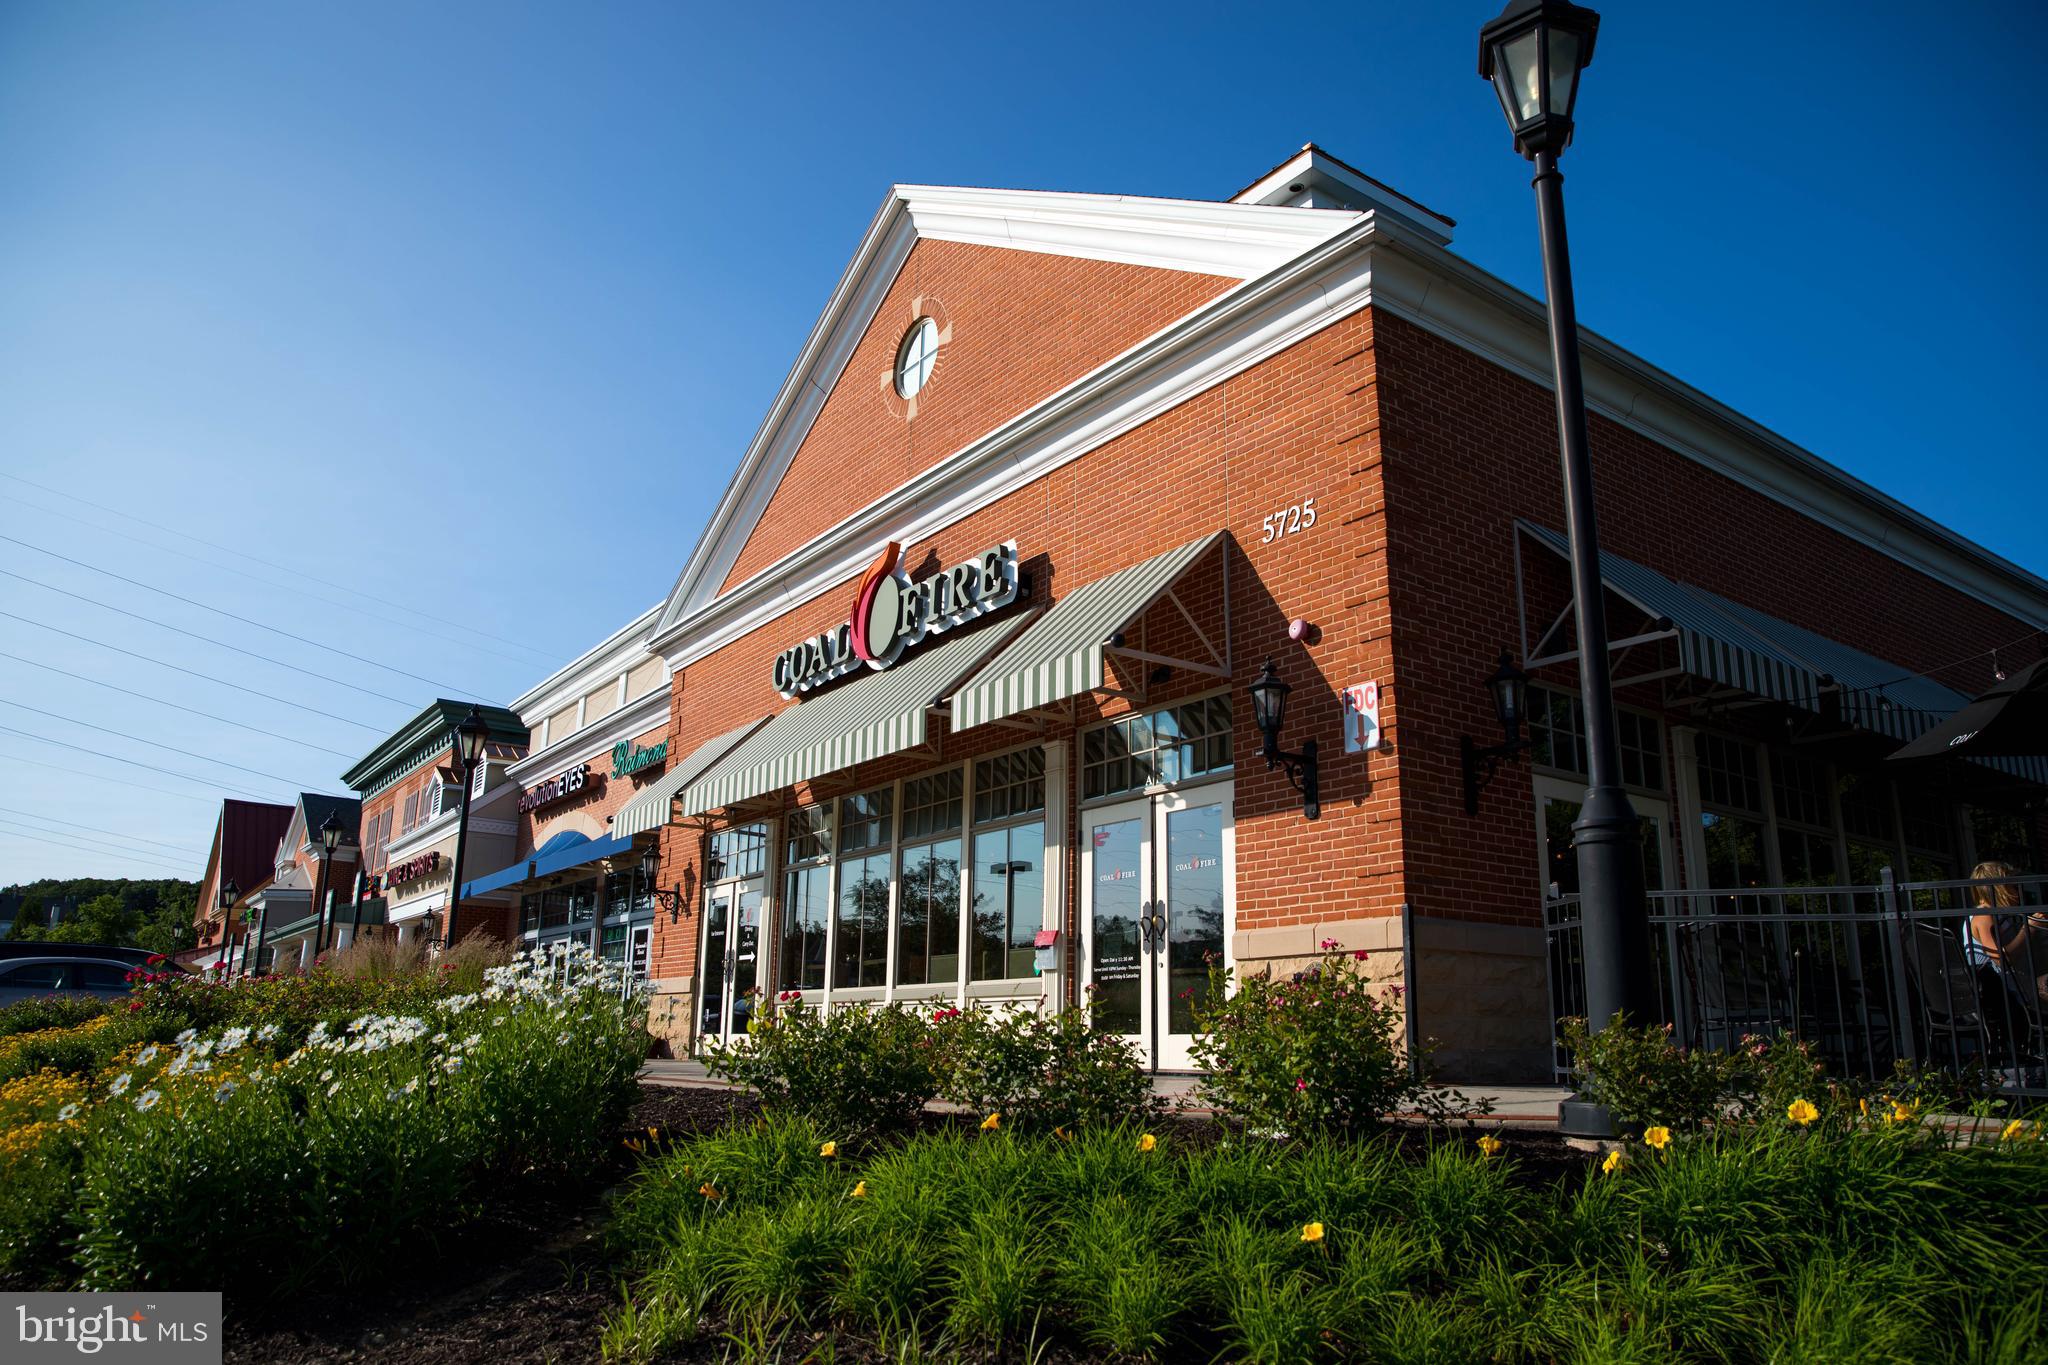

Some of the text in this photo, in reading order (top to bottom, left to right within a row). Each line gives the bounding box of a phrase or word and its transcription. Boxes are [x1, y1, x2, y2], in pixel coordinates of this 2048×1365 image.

[1262, 498, 1316, 543] 5725
[773, 543, 1012, 693] COAL FIRE
[1345, 685, 1375, 714] FDC
[1100, 870, 1136, 882] COAL FIRE
[1176, 859, 1217, 872] COAL FIRE
